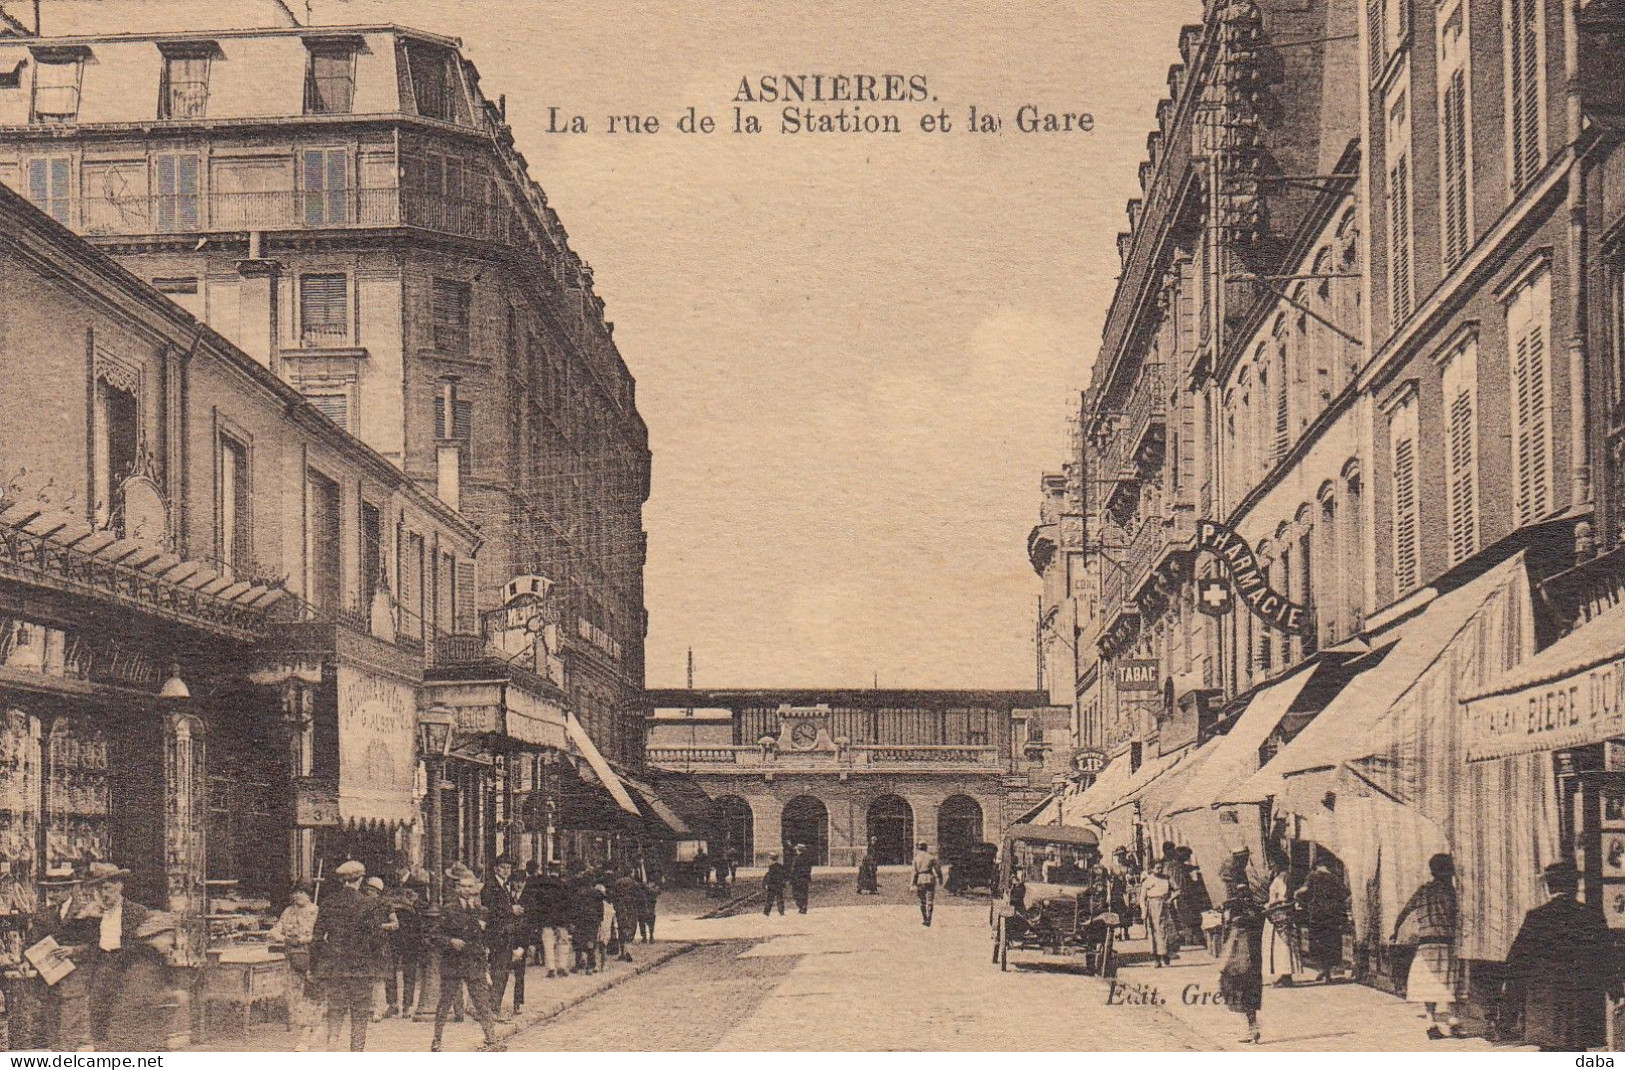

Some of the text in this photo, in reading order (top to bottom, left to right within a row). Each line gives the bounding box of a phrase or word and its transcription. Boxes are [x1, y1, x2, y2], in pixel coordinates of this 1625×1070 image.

[1201, 523, 1304, 629] PHARMACIE
[1120, 667, 1156, 682] TABAC
[1078, 758, 1104, 772] LIP
